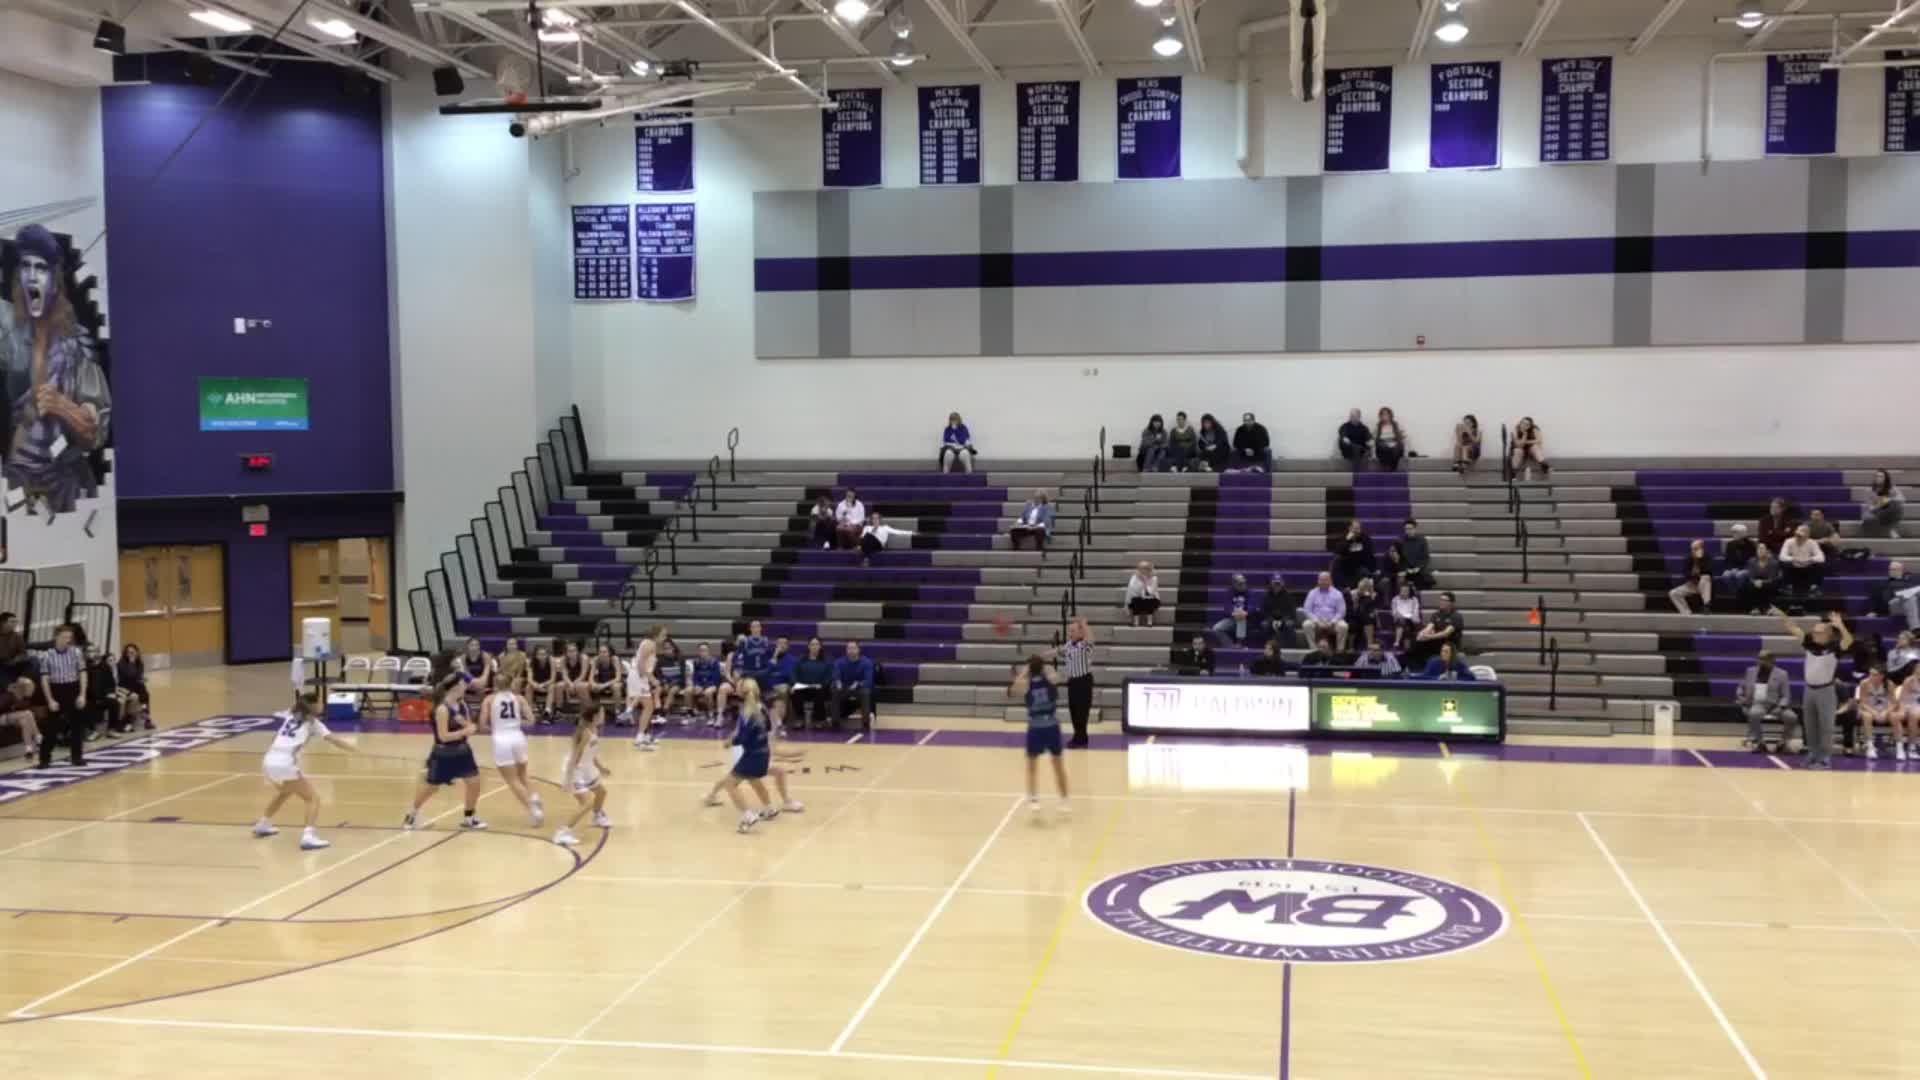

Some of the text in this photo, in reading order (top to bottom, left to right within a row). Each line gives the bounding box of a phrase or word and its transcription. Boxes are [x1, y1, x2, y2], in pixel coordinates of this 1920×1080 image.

[1438, 66, 1493, 81] FOOTBALL
[1448, 79, 1483, 89] SECTION
[1342, 91, 1376, 101] SECTION
[1442, 90, 1488, 101] CHAMPIONS
[1032, 104, 1065, 114] SECTION
[1134, 100, 1166, 110] SECTION
[1336, 102, 1381, 112] CHAMPIONS
[837, 112, 867, 120] SECTION
[935, 109, 965, 118] SECTION
[1128, 111, 1171, 121] CHAMPIONS
[929, 120, 970, 129] CHAMPIONS
[1027, 115, 1069, 125] CHAMPIONS
[832, 121, 872, 131] CHAMPIONS
[645, 127, 684, 136] CHAMPIONS
[225, 391, 256, 405] AHN
[500, 701, 516, 719] 21
[1136, 858, 1457, 894] SCHOOL DISTRICT
[1156, 888, 1429, 930] BW
[1104, 908, 1487, 961] BALDWIN WHITEHALL
